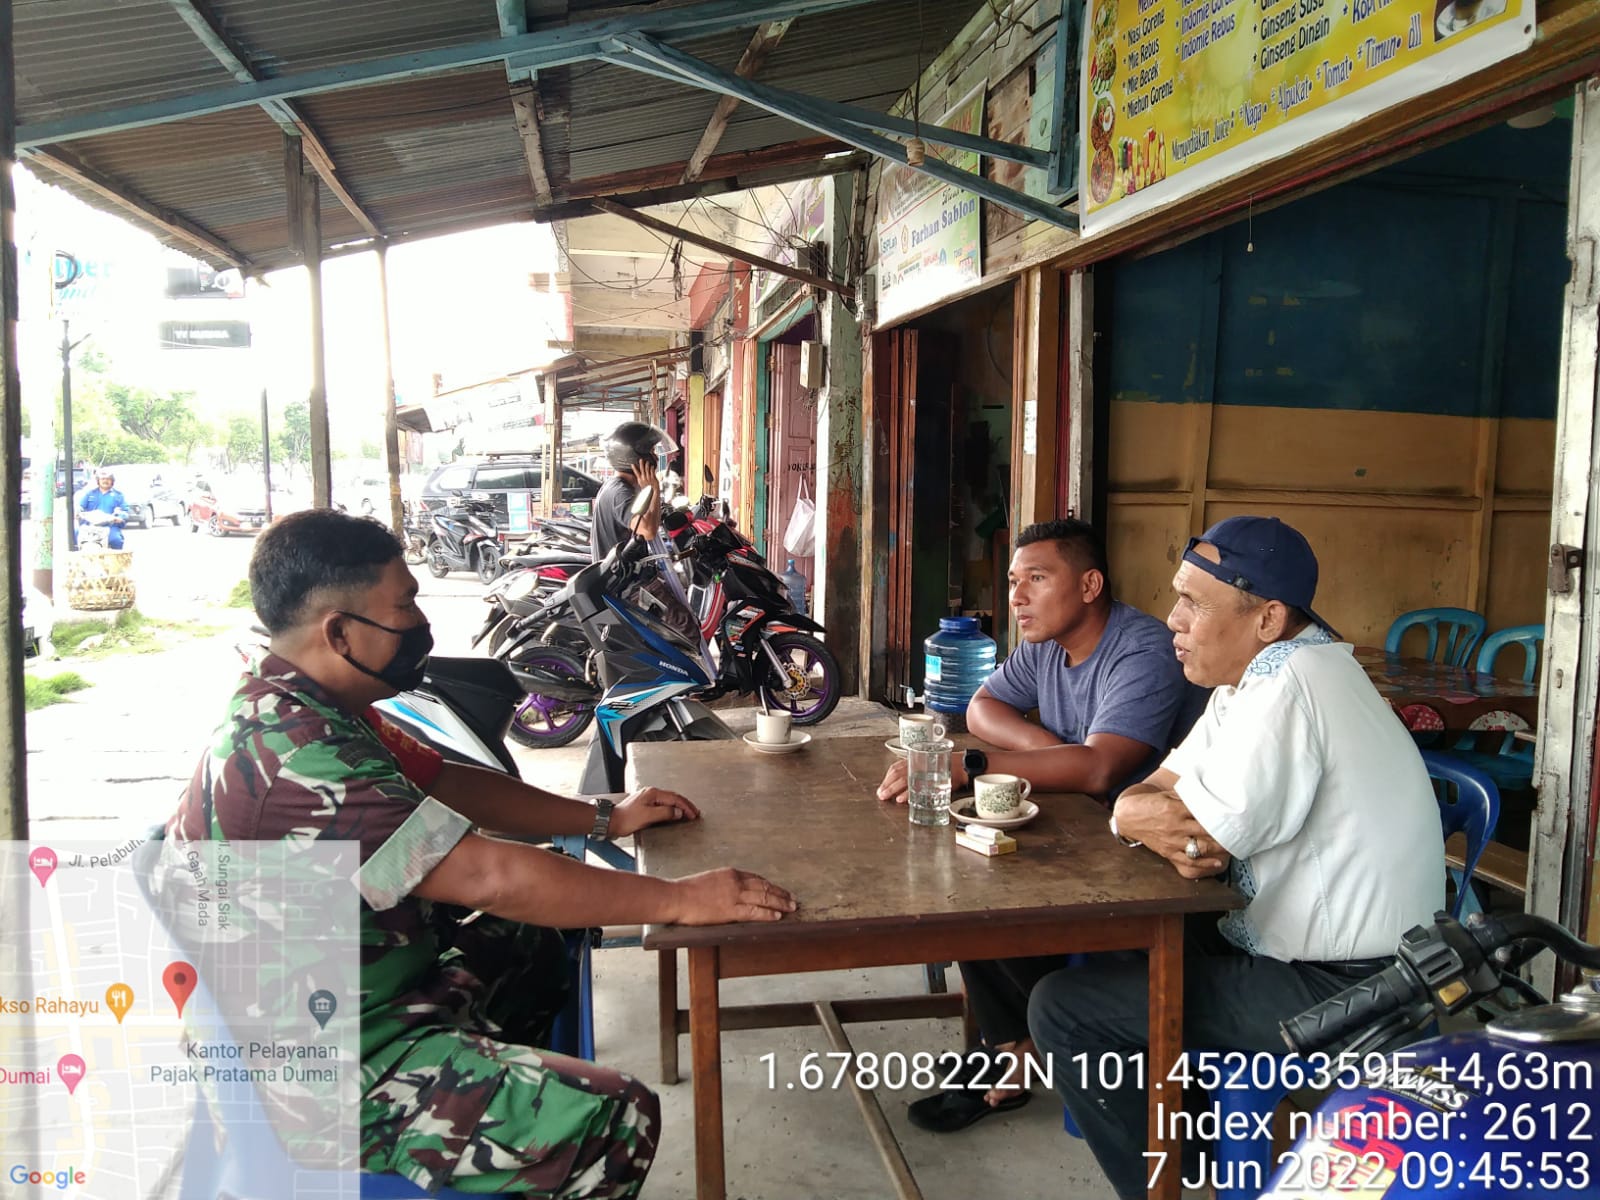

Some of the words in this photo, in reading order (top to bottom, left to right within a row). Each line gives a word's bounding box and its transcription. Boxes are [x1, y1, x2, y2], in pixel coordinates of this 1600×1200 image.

[1181, 3, 1209, 35] Indomie
[1181, 30, 1209, 61] Indomie
[1211, 13, 1236, 42] Rebus
[1261, 4, 1297, 40] Ginseng
[1408, 13, 1422, 50] dll
[1128, 51, 1139, 70] Mie
[1140, 38, 1160, 63] Rebus
[1261, 34, 1297, 70] Ginseng
[1299, 15, 1330, 49] Dingin
[1127, 75, 1139, 95] Mie
[911, 219, 940, 248] Farhan
[941, 198, 976, 229] Sablon
[659, 660, 689, 677] HONDA
